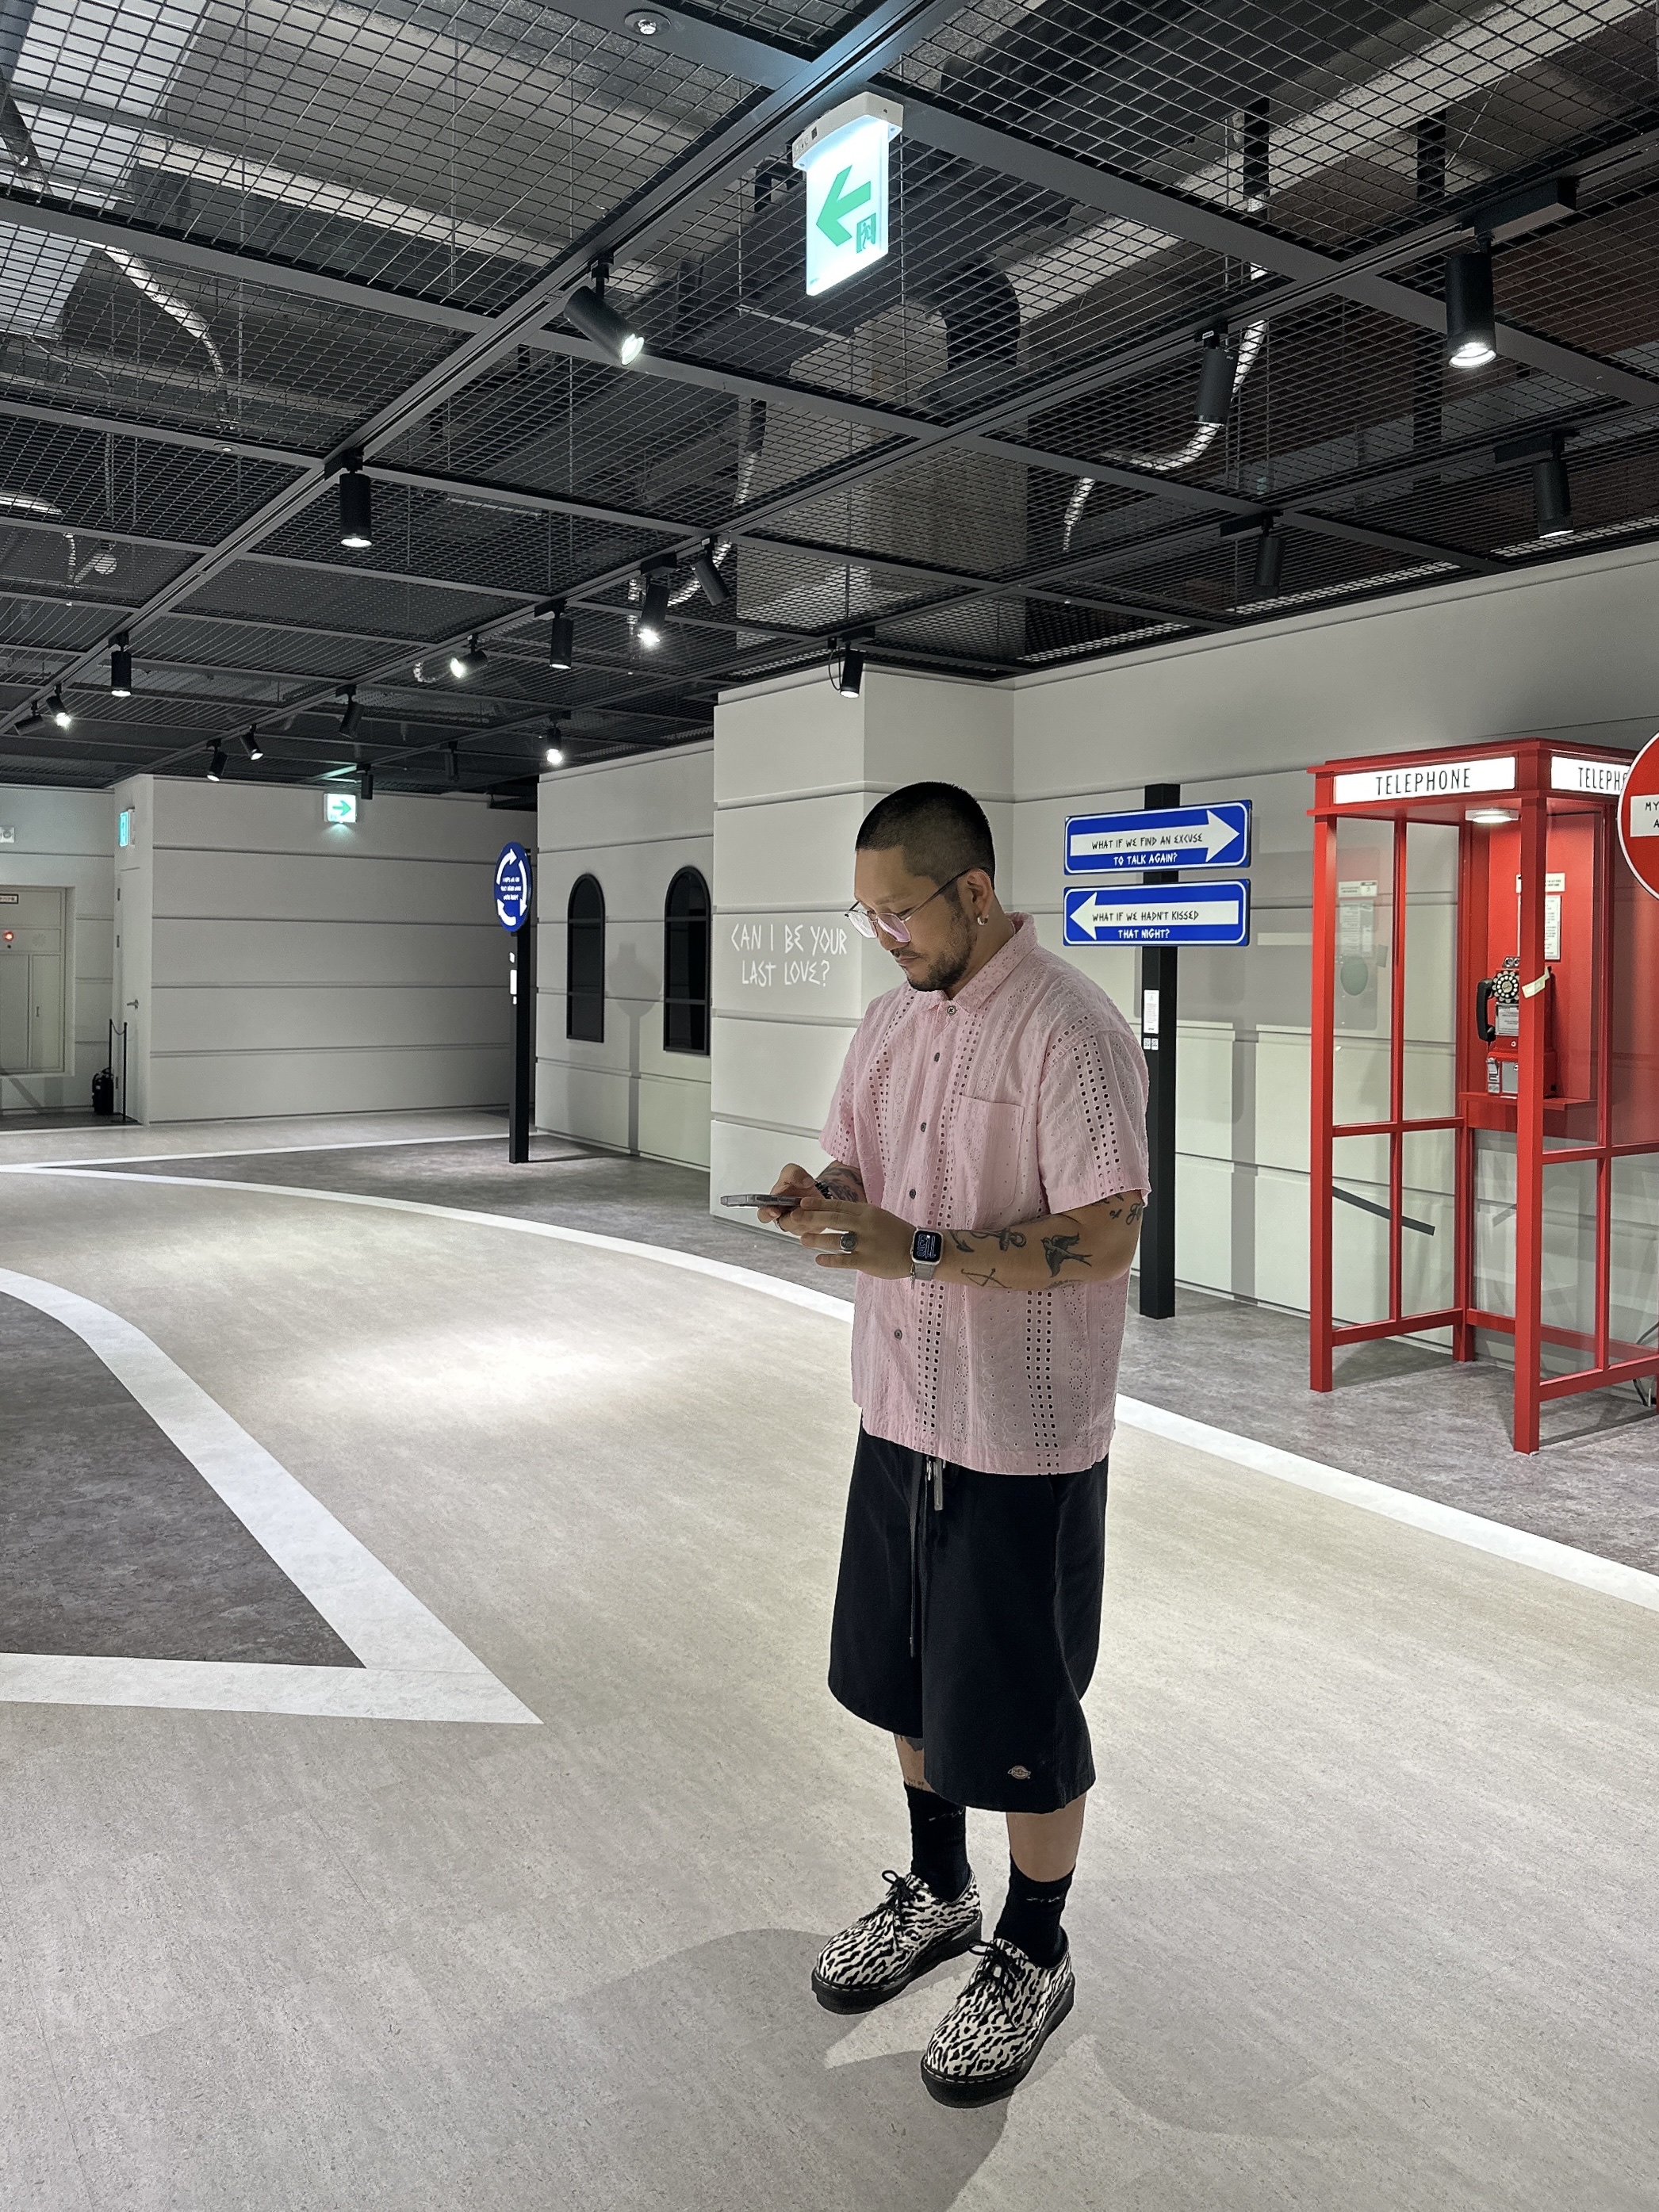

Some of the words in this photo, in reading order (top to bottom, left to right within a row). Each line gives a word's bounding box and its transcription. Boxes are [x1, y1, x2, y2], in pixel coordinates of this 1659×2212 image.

[1376, 767, 1470, 796] TELEPHONE
[1645, 802, 1659, 811] MY
[1091, 840, 1113, 850] WHAT
[1116, 839, 1123, 848] IF
[1126, 837, 1137, 848] WE
[1140, 836, 1157, 847] FIND
[1160, 835, 1171, 845] AN
[1174, 832, 1203, 844] EXCUSE
[1113, 855, 1125, 866] TO
[1127, 854, 1146, 865] TALK
[1148, 852, 1178, 864] AGAIN?
[1092, 912, 1113, 922] WHAT
[1116, 912, 1124, 921] IF
[1126, 912, 1137, 921] WE
[1140, 911, 1169, 921] HADN'T
[1171, 910, 1199, 920] KISSED
[731, 923, 761, 951] CAN
[770, 924, 774, 951] I
[784, 924, 804, 954] BE
[810, 925, 847, 956] YOUR
[1117, 929, 1139, 939] THAT
[1141, 928, 1170, 939] NIGHT?
[741, 960, 776, 987] LAST
[784, 959, 830, 987] LOVE?
